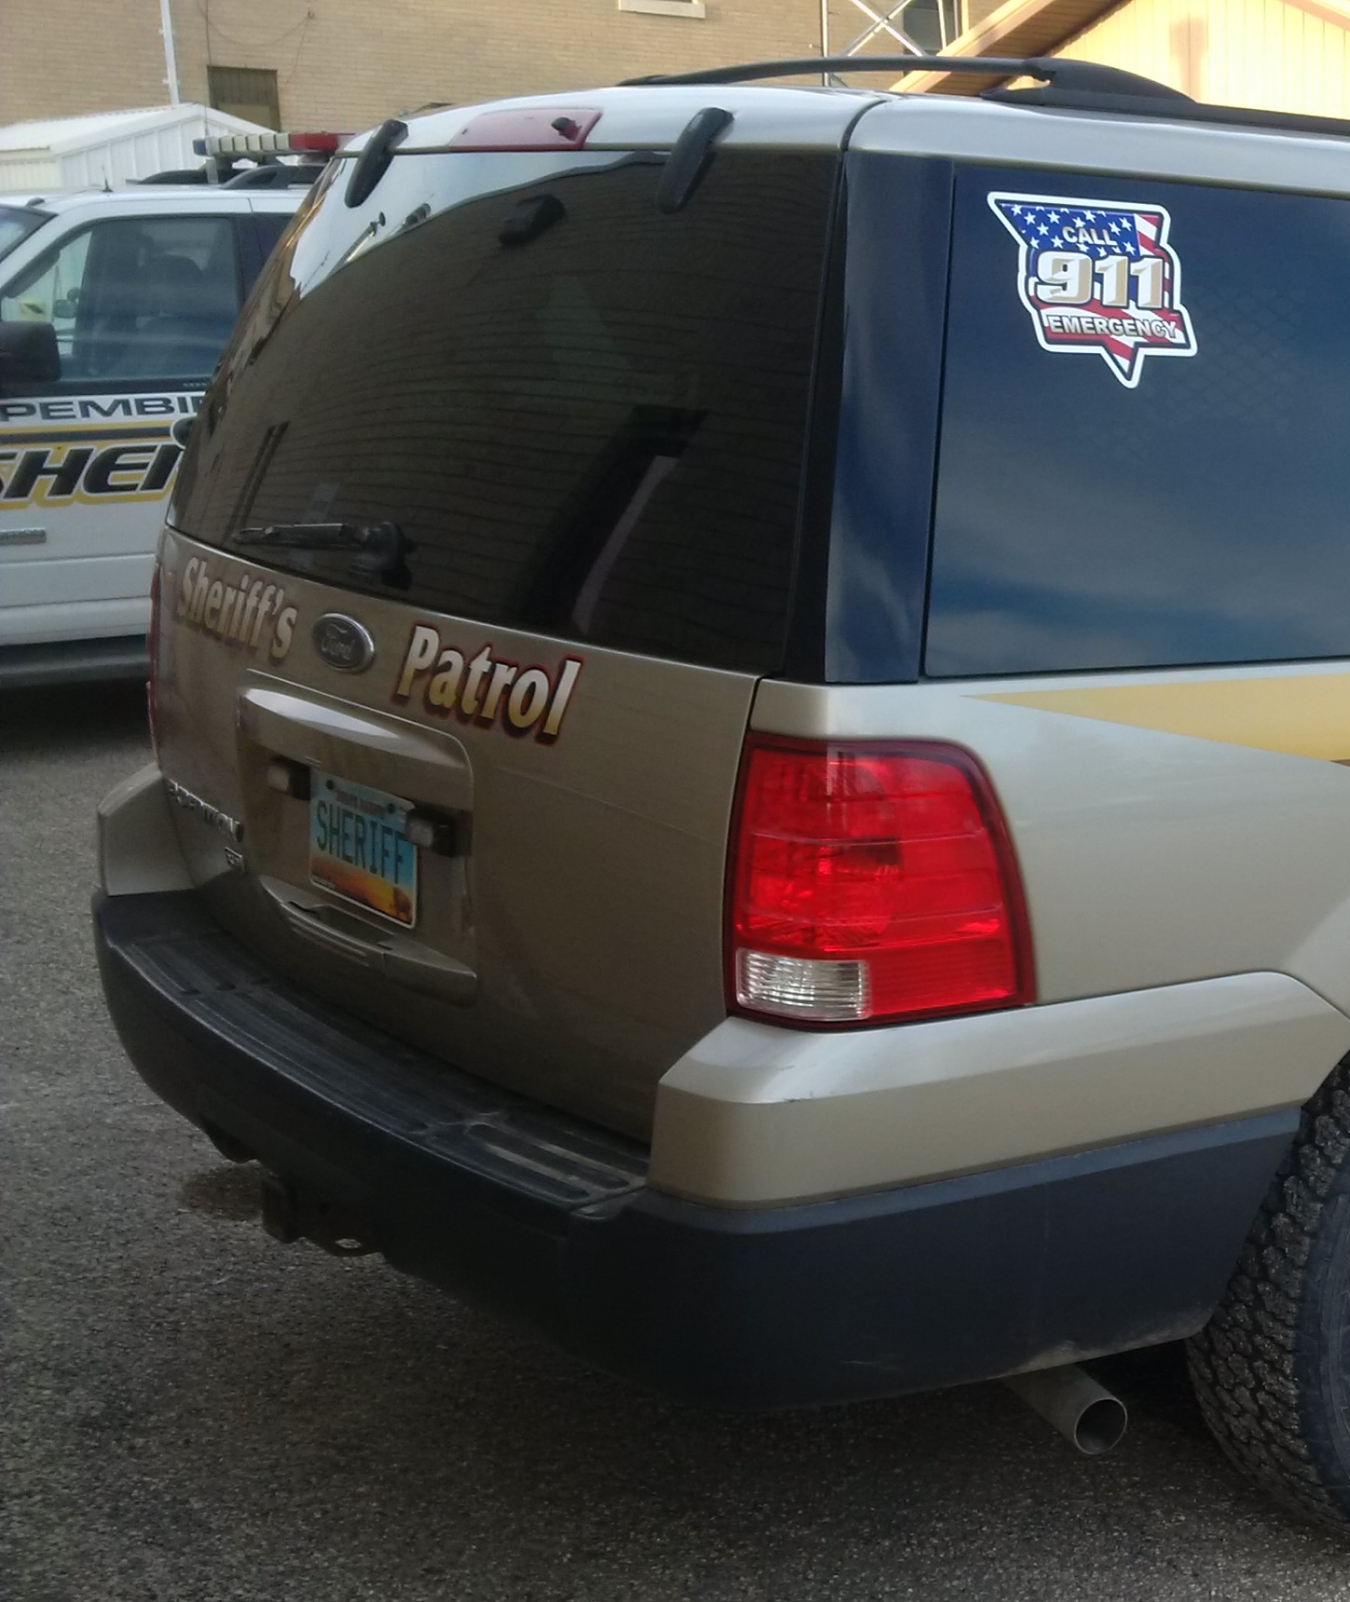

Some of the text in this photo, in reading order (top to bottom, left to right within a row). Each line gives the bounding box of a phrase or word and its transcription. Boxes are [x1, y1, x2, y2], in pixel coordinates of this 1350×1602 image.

[1060, 225, 1118, 247] CALL
[1035, 250, 1165, 309] 911
[1045, 314, 1178, 339] EMERGENCY
[178, 557, 583, 743] Sheriff's Patrol
[316, 800, 407, 885] SHERIFF
